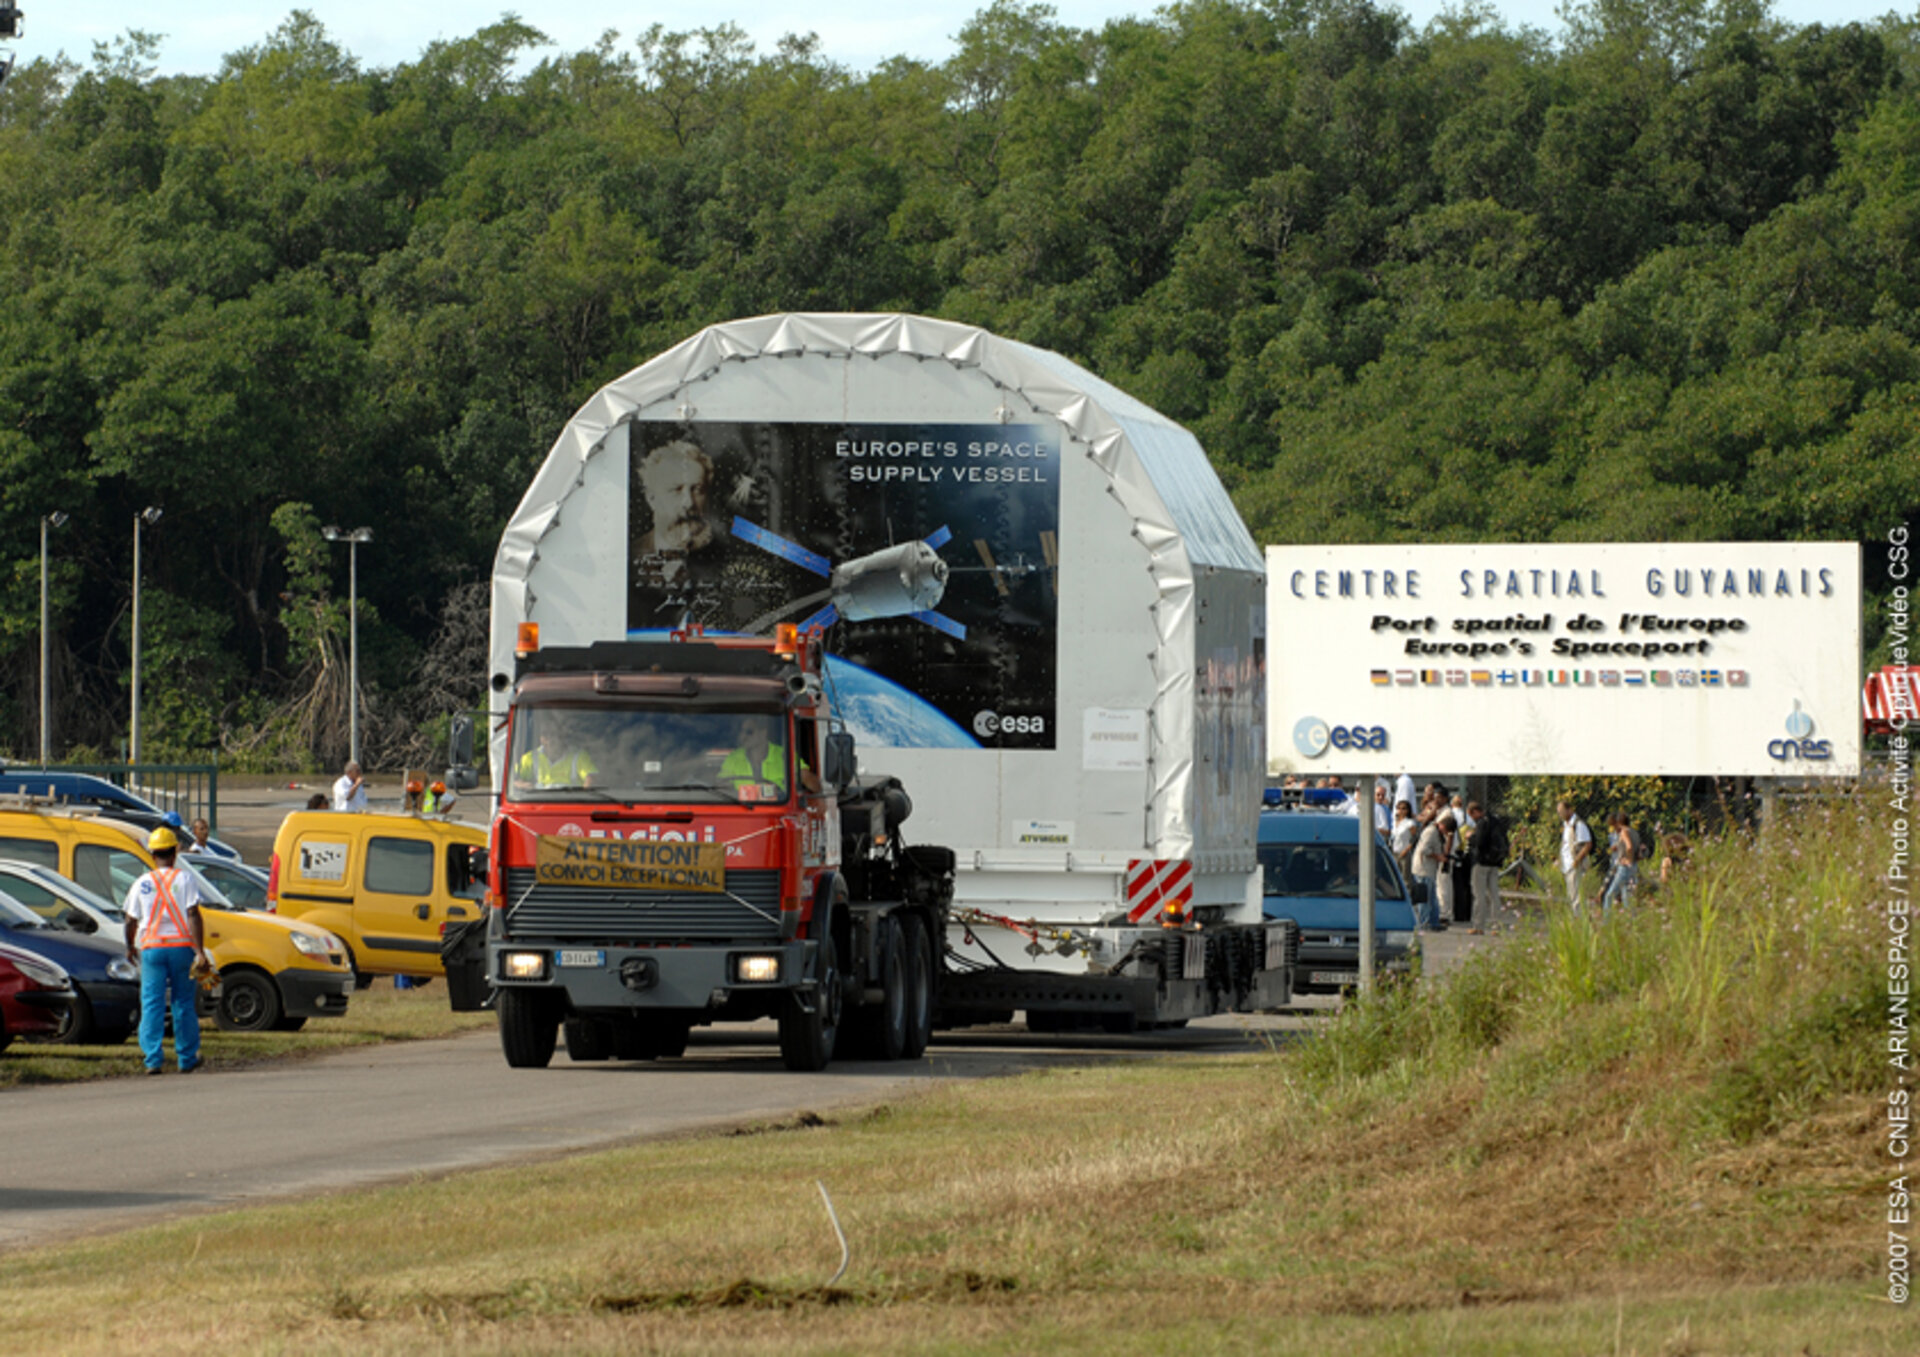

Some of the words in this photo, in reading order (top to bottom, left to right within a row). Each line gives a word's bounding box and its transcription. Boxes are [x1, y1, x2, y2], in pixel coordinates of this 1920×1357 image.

[836, 441, 958, 457] EUROPE'S
[968, 441, 1048, 457] SPACE
[850, 465, 943, 482] SUPPLY
[952, 466, 1048, 482] VESSEL
[1291, 570, 1420, 599] CENTRE
[1460, 569, 1606, 598] SPATIAL
[1646, 568, 1835, 598] GUYANAIS
[1371, 615, 1436, 632] Port
[1453, 613, 1552, 634] spatial
[1566, 614, 1604, 632] de
[1619, 613, 1746, 634] l'Europe
[1404, 638, 1533, 659] Europe's
[1552, 638, 1710, 659] Spaceport
[1000, 715, 1044, 733] esa
[1330, 725, 1388, 750] esa
[1767, 738, 1833, 761] cnes
[563, 841, 701, 866] ATTENTION!
[540, 863, 605, 882] CONVOI
[611, 867, 719, 887] EXCEPTIONAL
